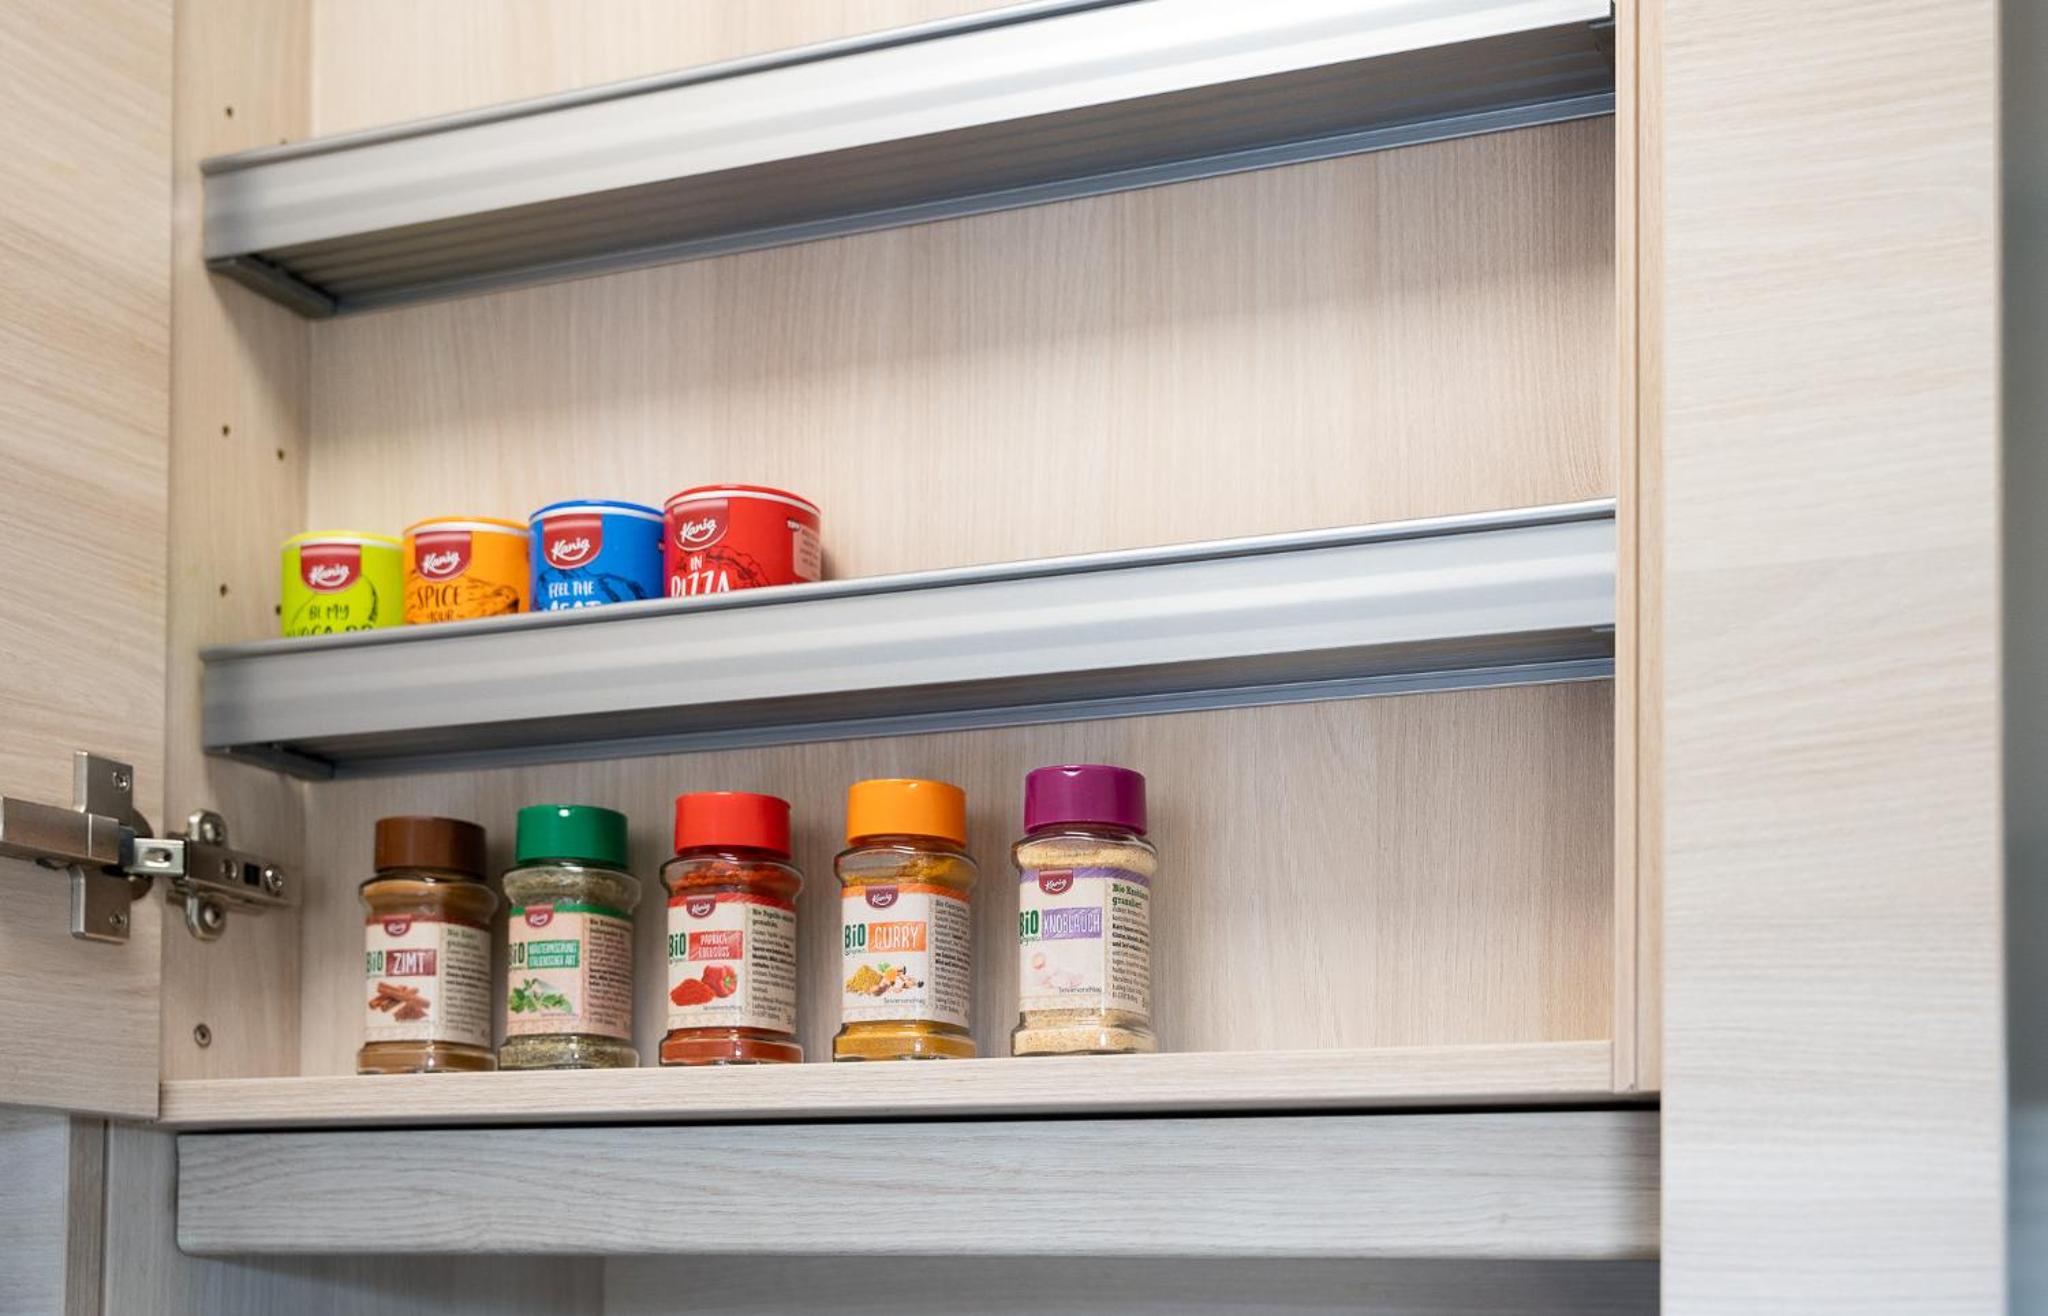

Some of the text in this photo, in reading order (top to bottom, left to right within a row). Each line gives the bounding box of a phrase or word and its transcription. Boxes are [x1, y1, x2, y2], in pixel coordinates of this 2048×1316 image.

[690, 555, 703, 571] IN
[417, 584, 461, 609] SPICE
[1044, 912, 1100, 934] KNOBLAUCH
[875, 925, 918, 949] CURRY
[393, 952, 426, 974] ZIMT
